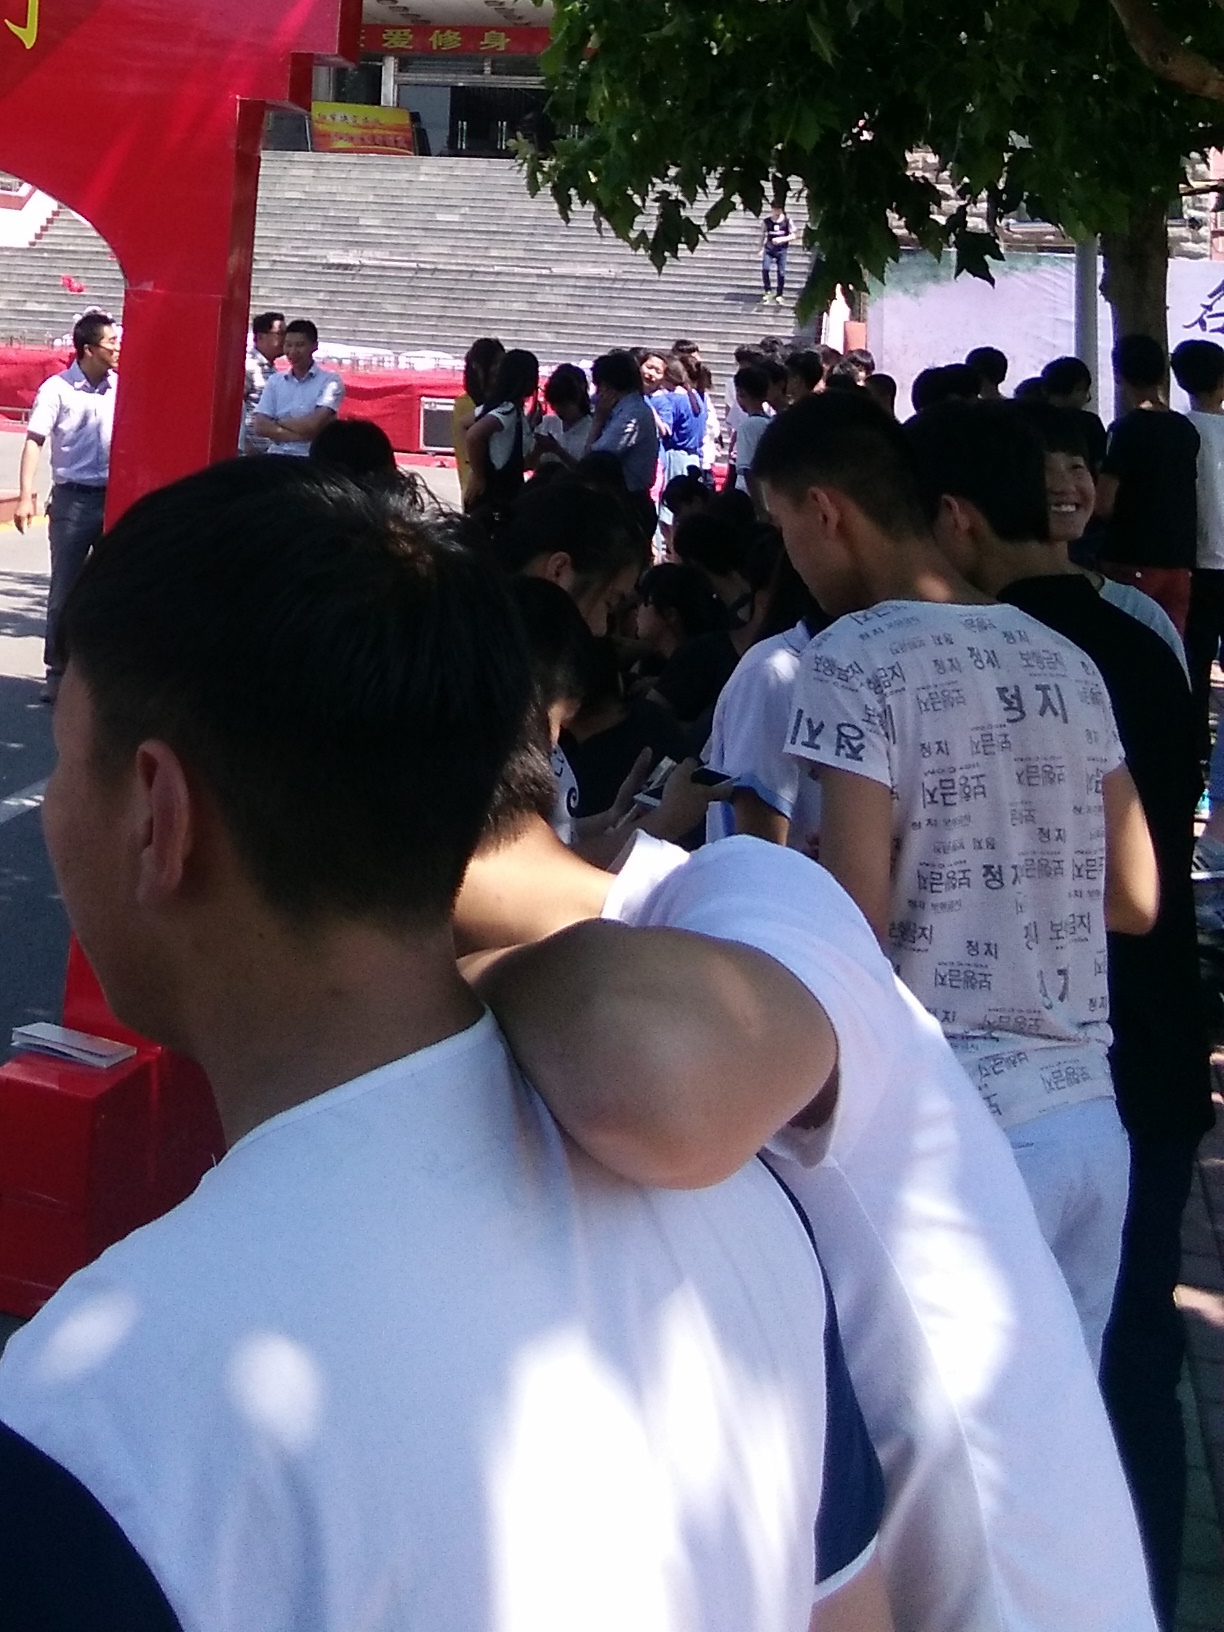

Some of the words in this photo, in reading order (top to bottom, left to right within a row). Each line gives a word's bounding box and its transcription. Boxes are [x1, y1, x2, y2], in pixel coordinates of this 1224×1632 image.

[360, 28, 511, 51] 爱修身
[813, 654, 864, 683] 보행금지
[935, 968, 993, 991] 보행금지
